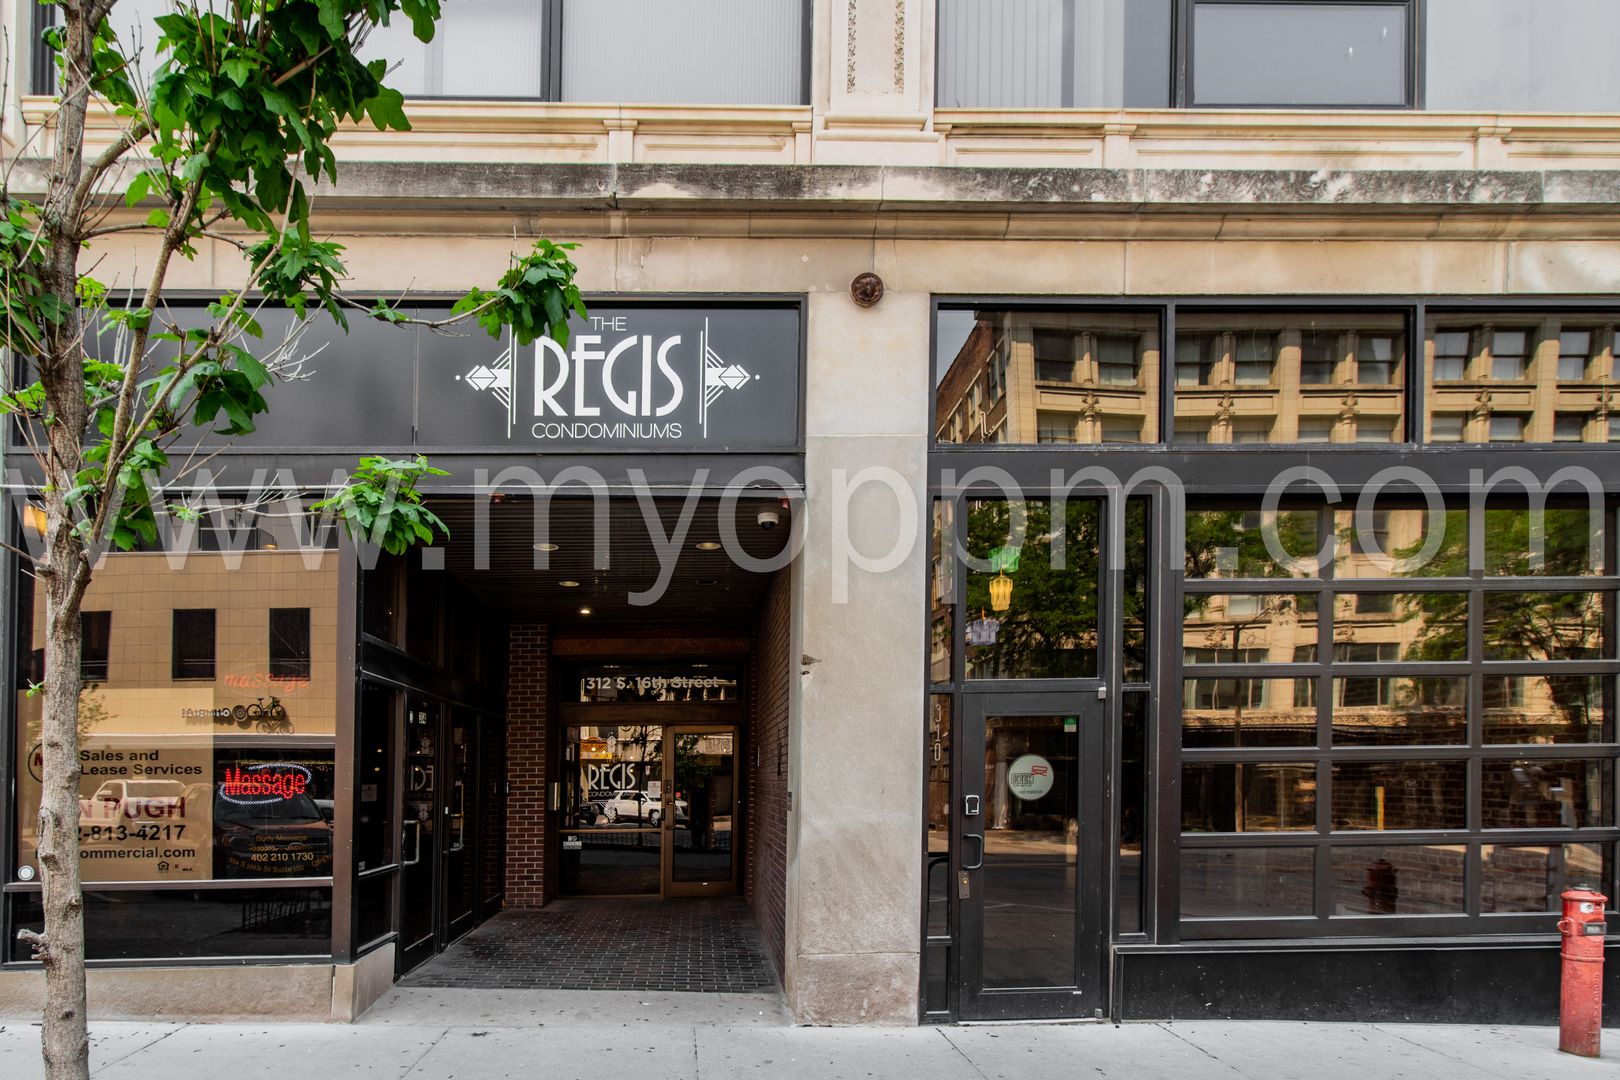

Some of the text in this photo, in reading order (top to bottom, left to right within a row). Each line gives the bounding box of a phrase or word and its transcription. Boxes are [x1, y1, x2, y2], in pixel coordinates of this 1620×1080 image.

[590, 316, 627, 331] THE
[533, 334, 684, 417] REGIS
[531, 422, 682, 439] CONDOMINIUMS
[586, 676, 719, 689] 312 S. 16th Street
[80, 750, 159, 761] Sales and
[80, 764, 203, 775] Lease Services
[225, 767, 306, 798] Massage
[587, 763, 636, 791] REGIS
[79, 847, 196, 858] ommercial.com
[251, 852, 314, 862] 402 210 1730
